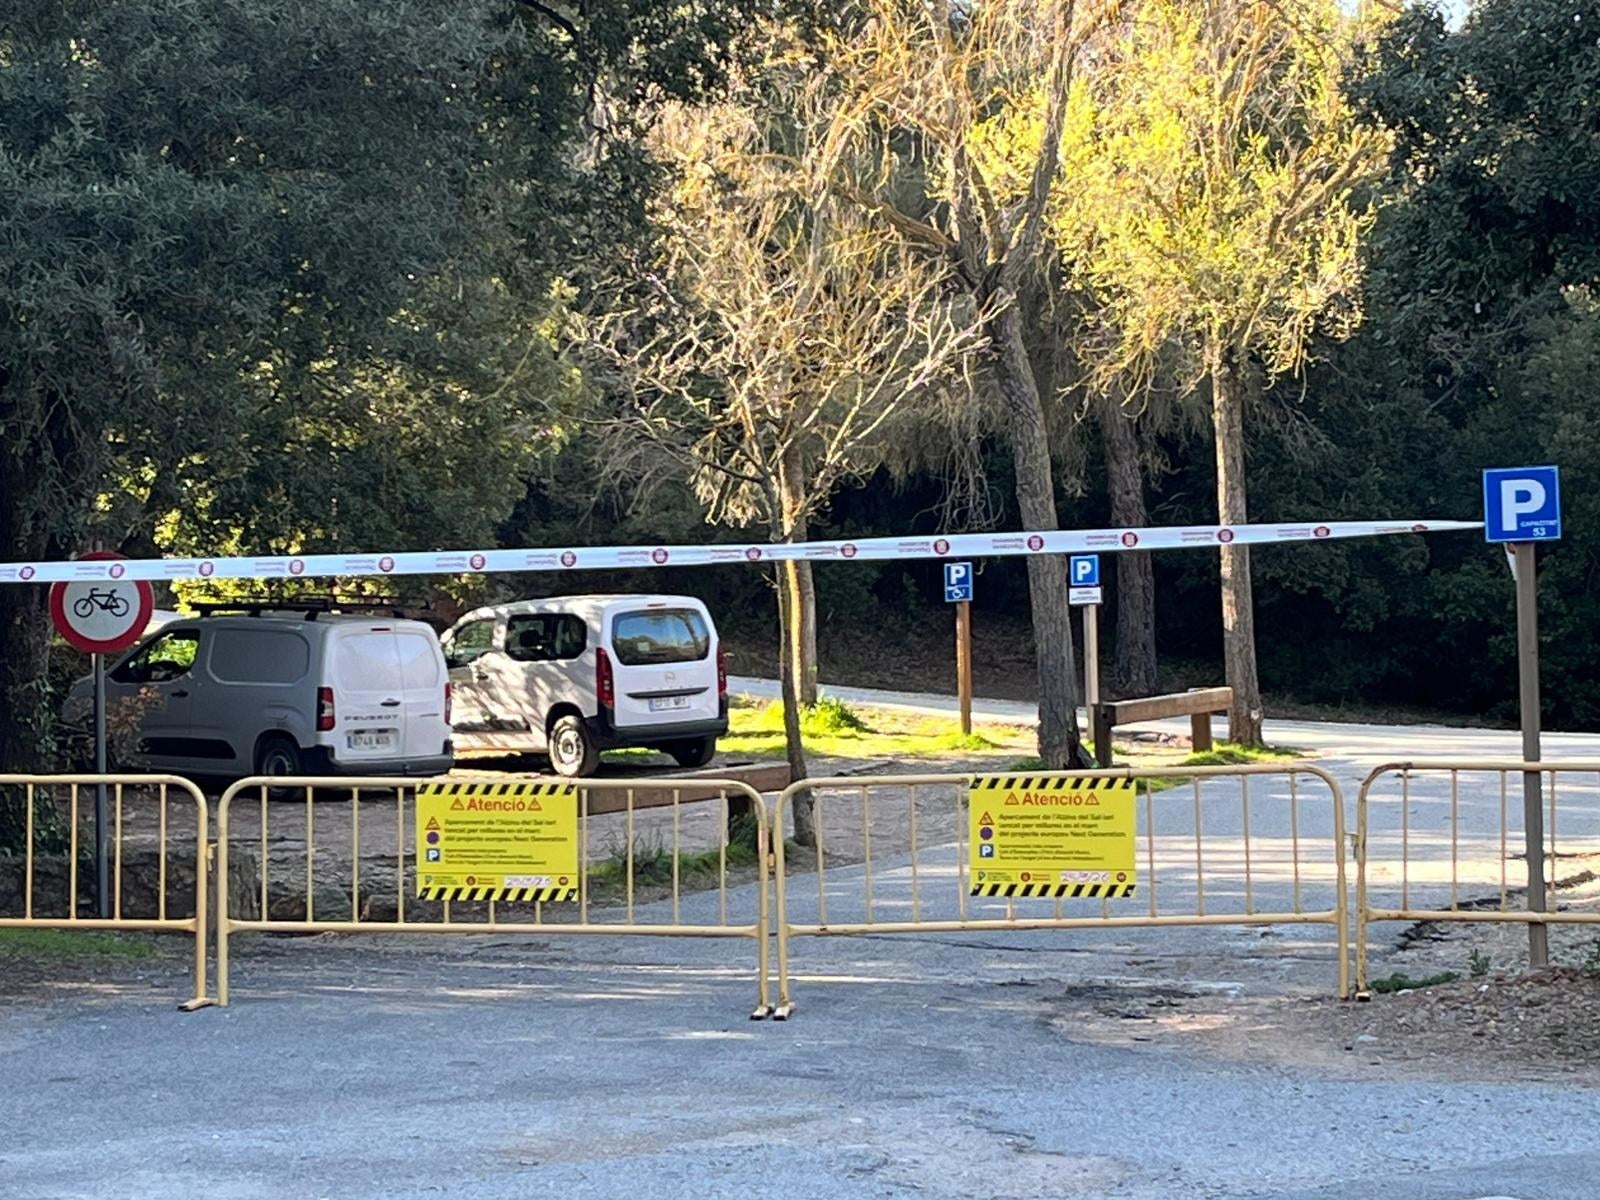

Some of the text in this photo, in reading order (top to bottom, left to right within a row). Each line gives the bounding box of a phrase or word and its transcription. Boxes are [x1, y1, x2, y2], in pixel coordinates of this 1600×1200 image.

[1500, 479, 1546, 531] P
[950, 565, 966, 584] P
[1076, 560, 1092, 582] P
[467, 798, 526, 811] Atenció
[1022, 792, 1083, 806] Atenció
[982, 846, 992, 856] P
